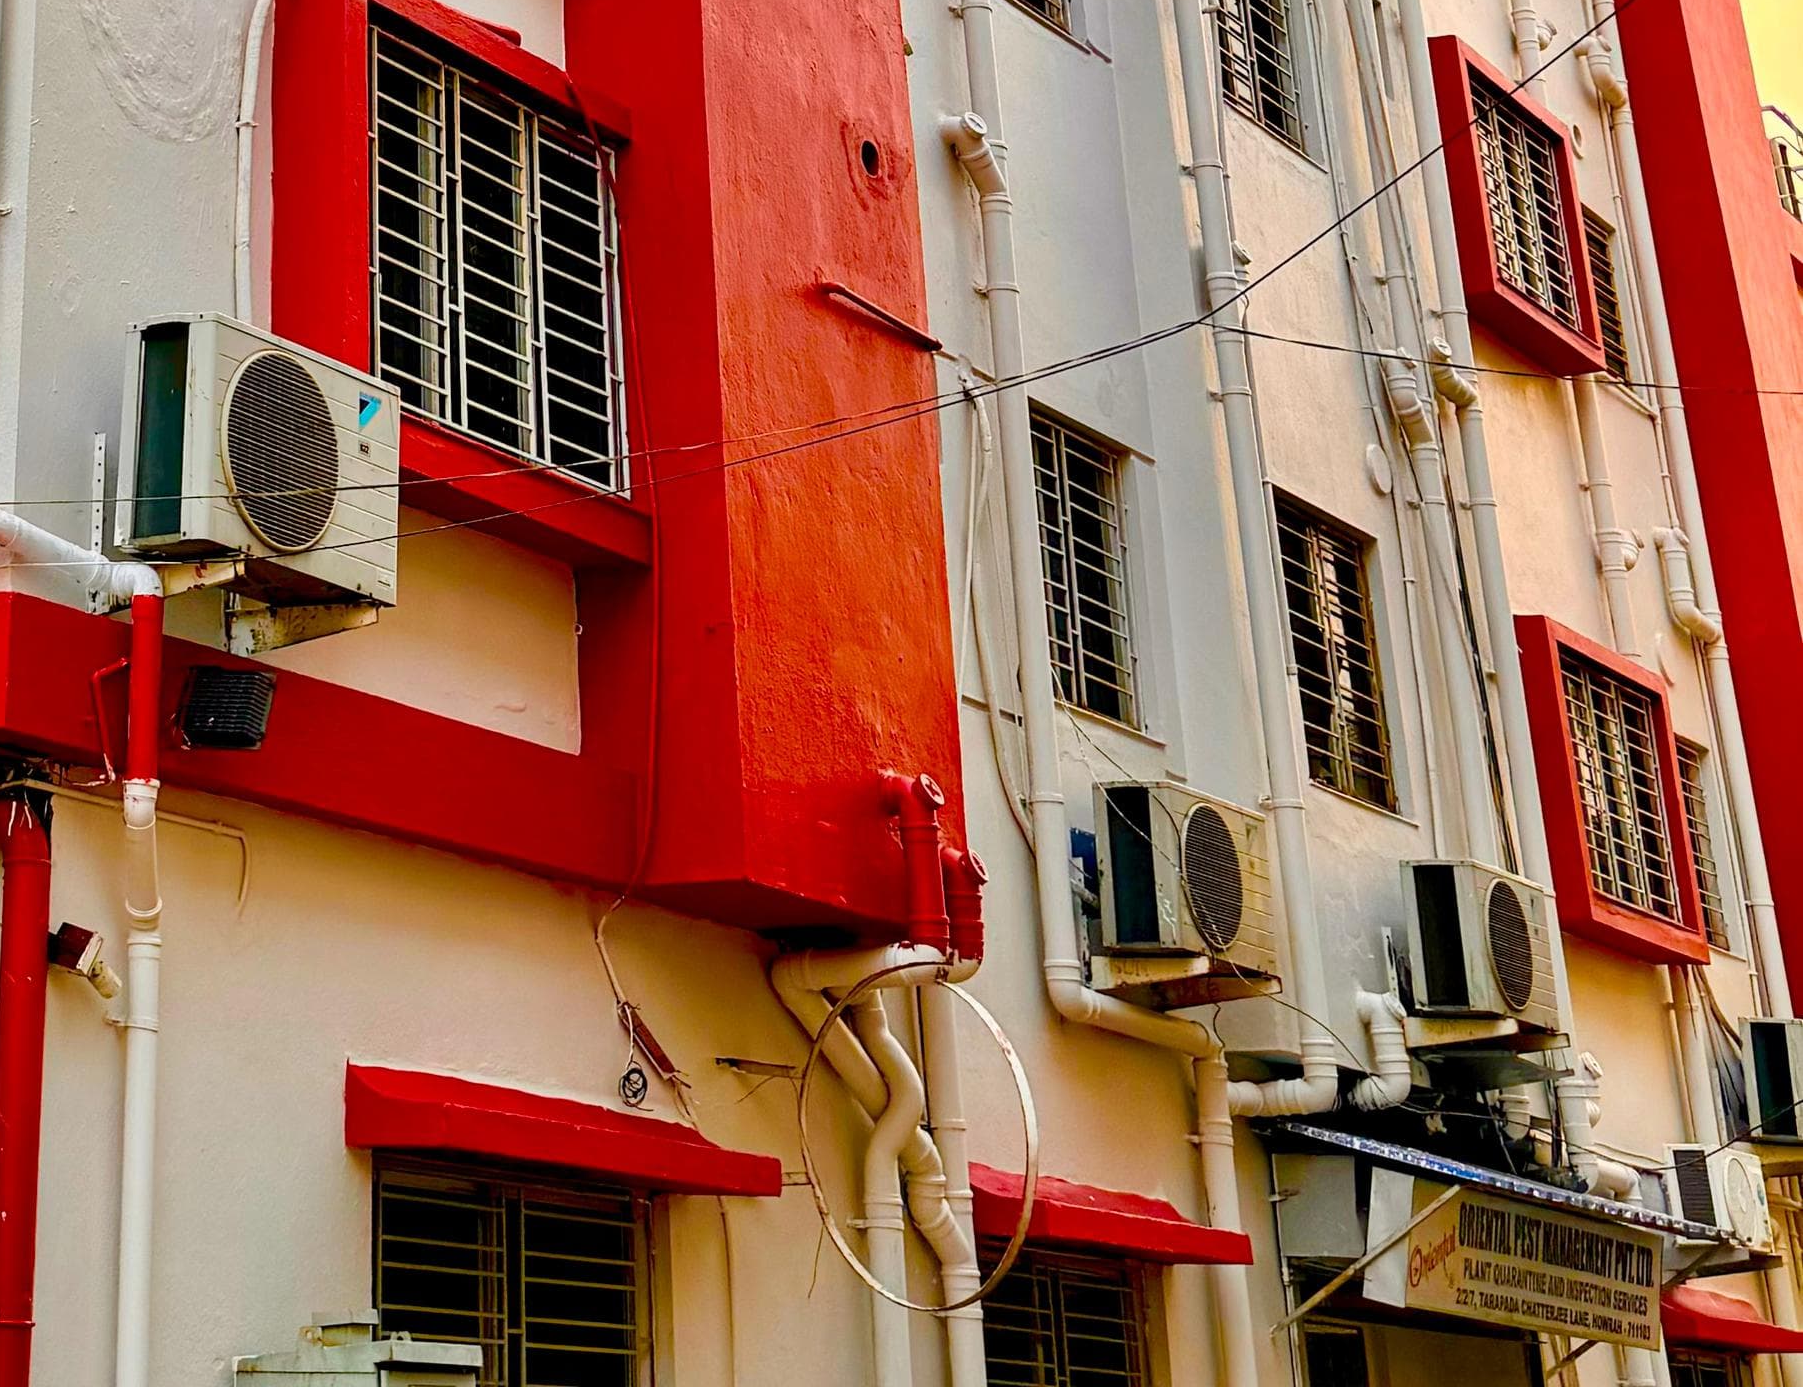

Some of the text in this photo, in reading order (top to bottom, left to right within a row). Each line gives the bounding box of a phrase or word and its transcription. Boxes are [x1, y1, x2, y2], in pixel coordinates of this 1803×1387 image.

[1459, 1201, 1512, 1256] ORIENTAL
[1513, 1214, 1542, 1262] PEST
[1463, 1258, 1492, 1284] PLANT
